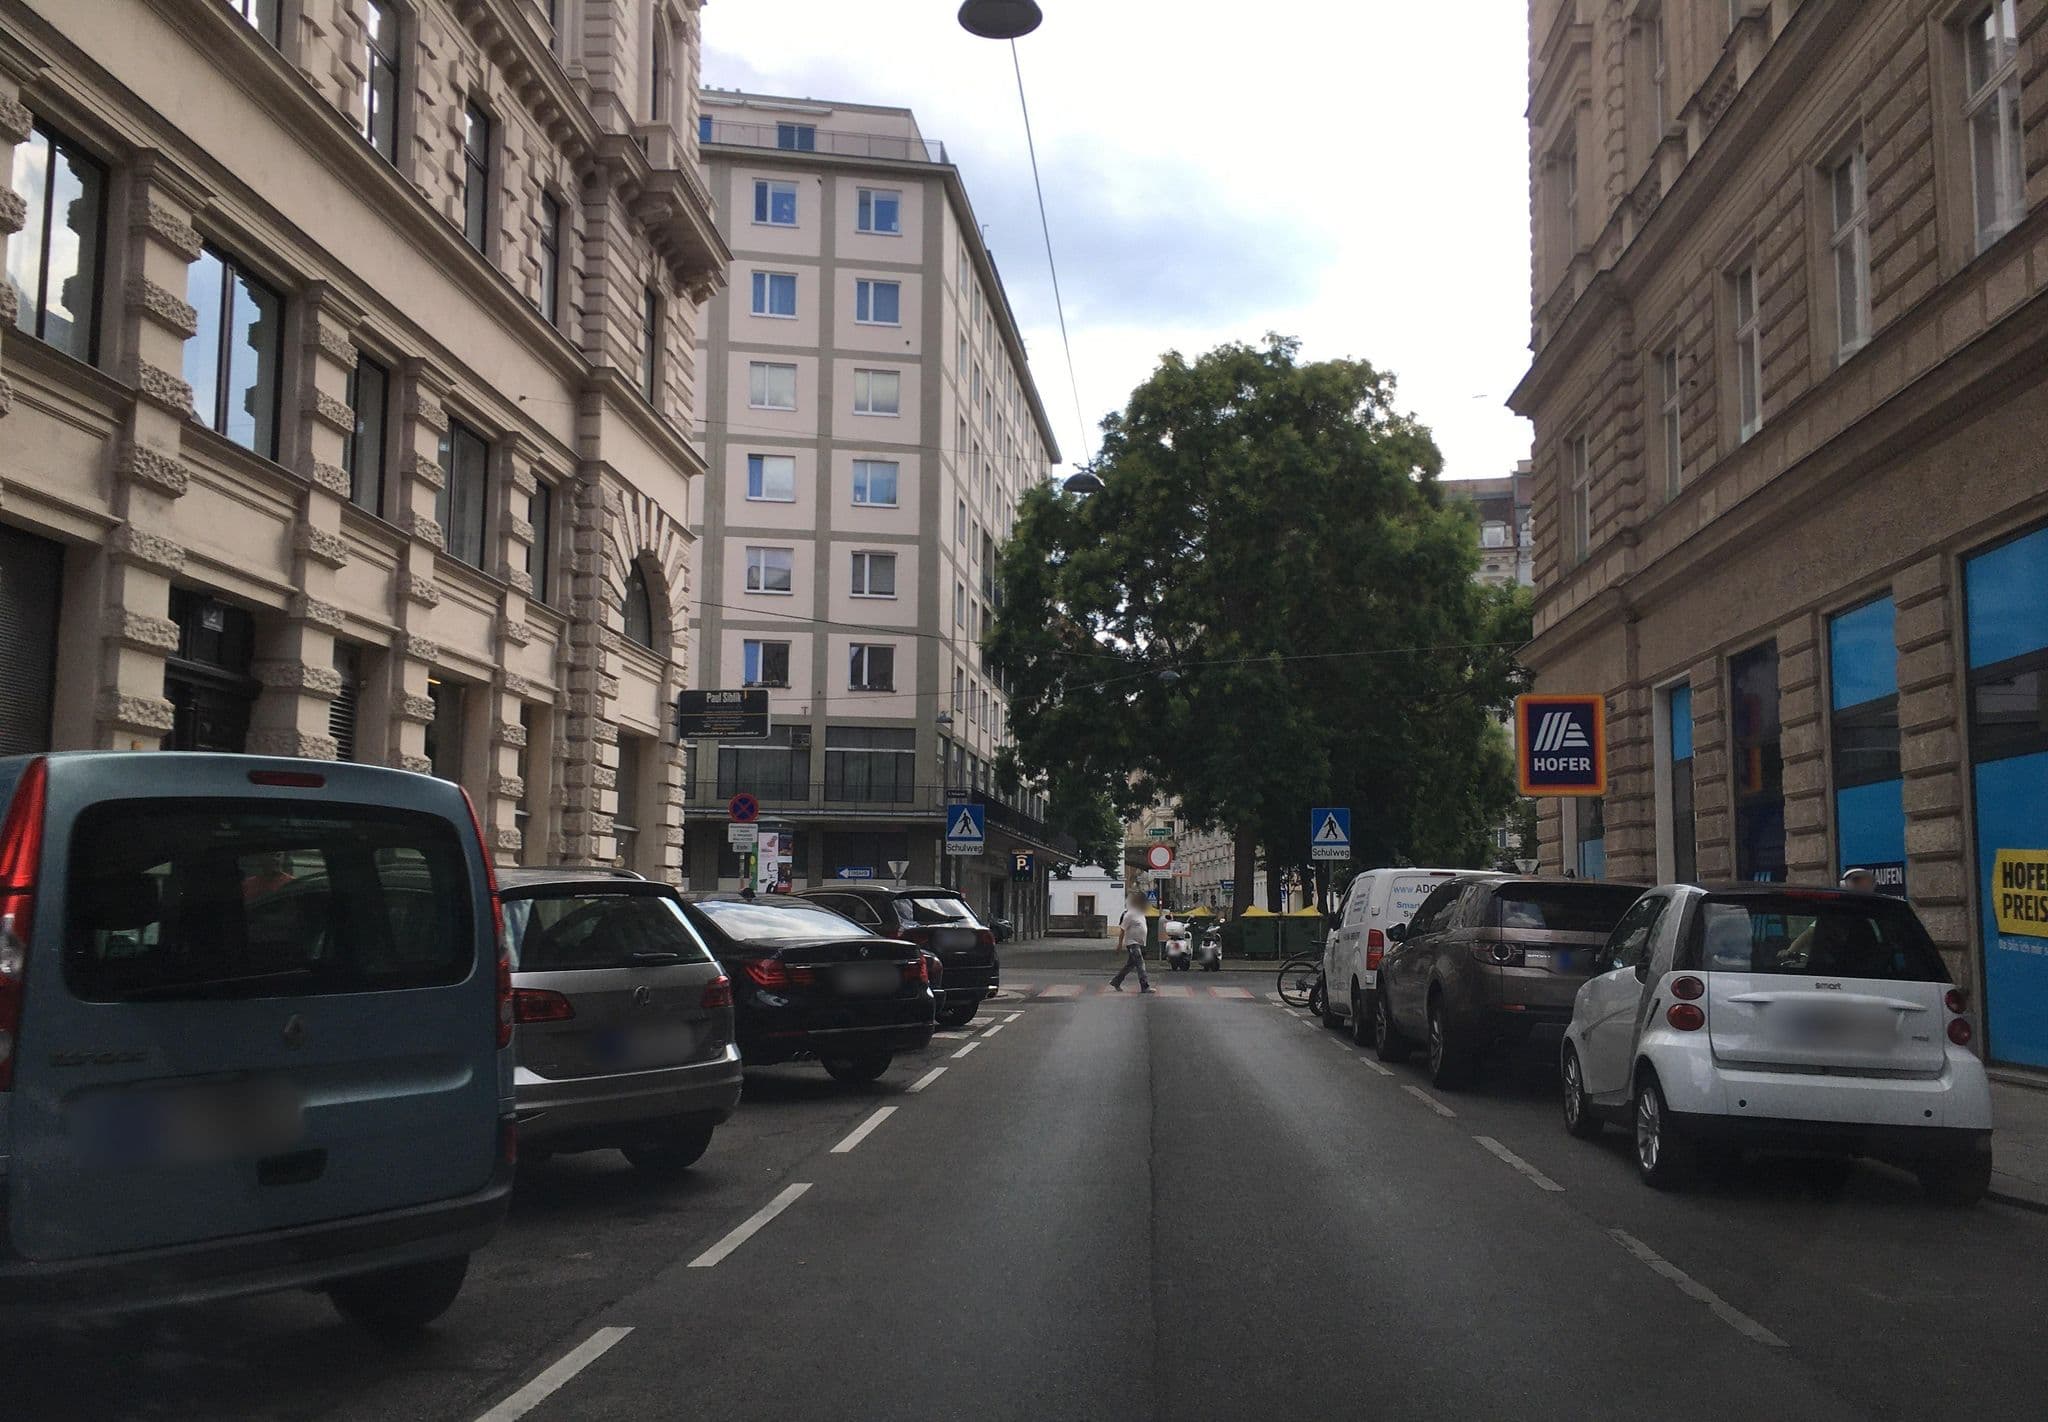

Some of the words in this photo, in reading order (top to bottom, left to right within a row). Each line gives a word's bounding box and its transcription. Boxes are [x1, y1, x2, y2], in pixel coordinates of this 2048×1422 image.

[1534, 757, 1591, 771] HOFER
[946, 843, 983, 854] Schulweg
[1312, 848, 1350, 858] Schulweg
[1016, 858, 1027, 871] P
[2002, 861, 2048, 890] HOFE
